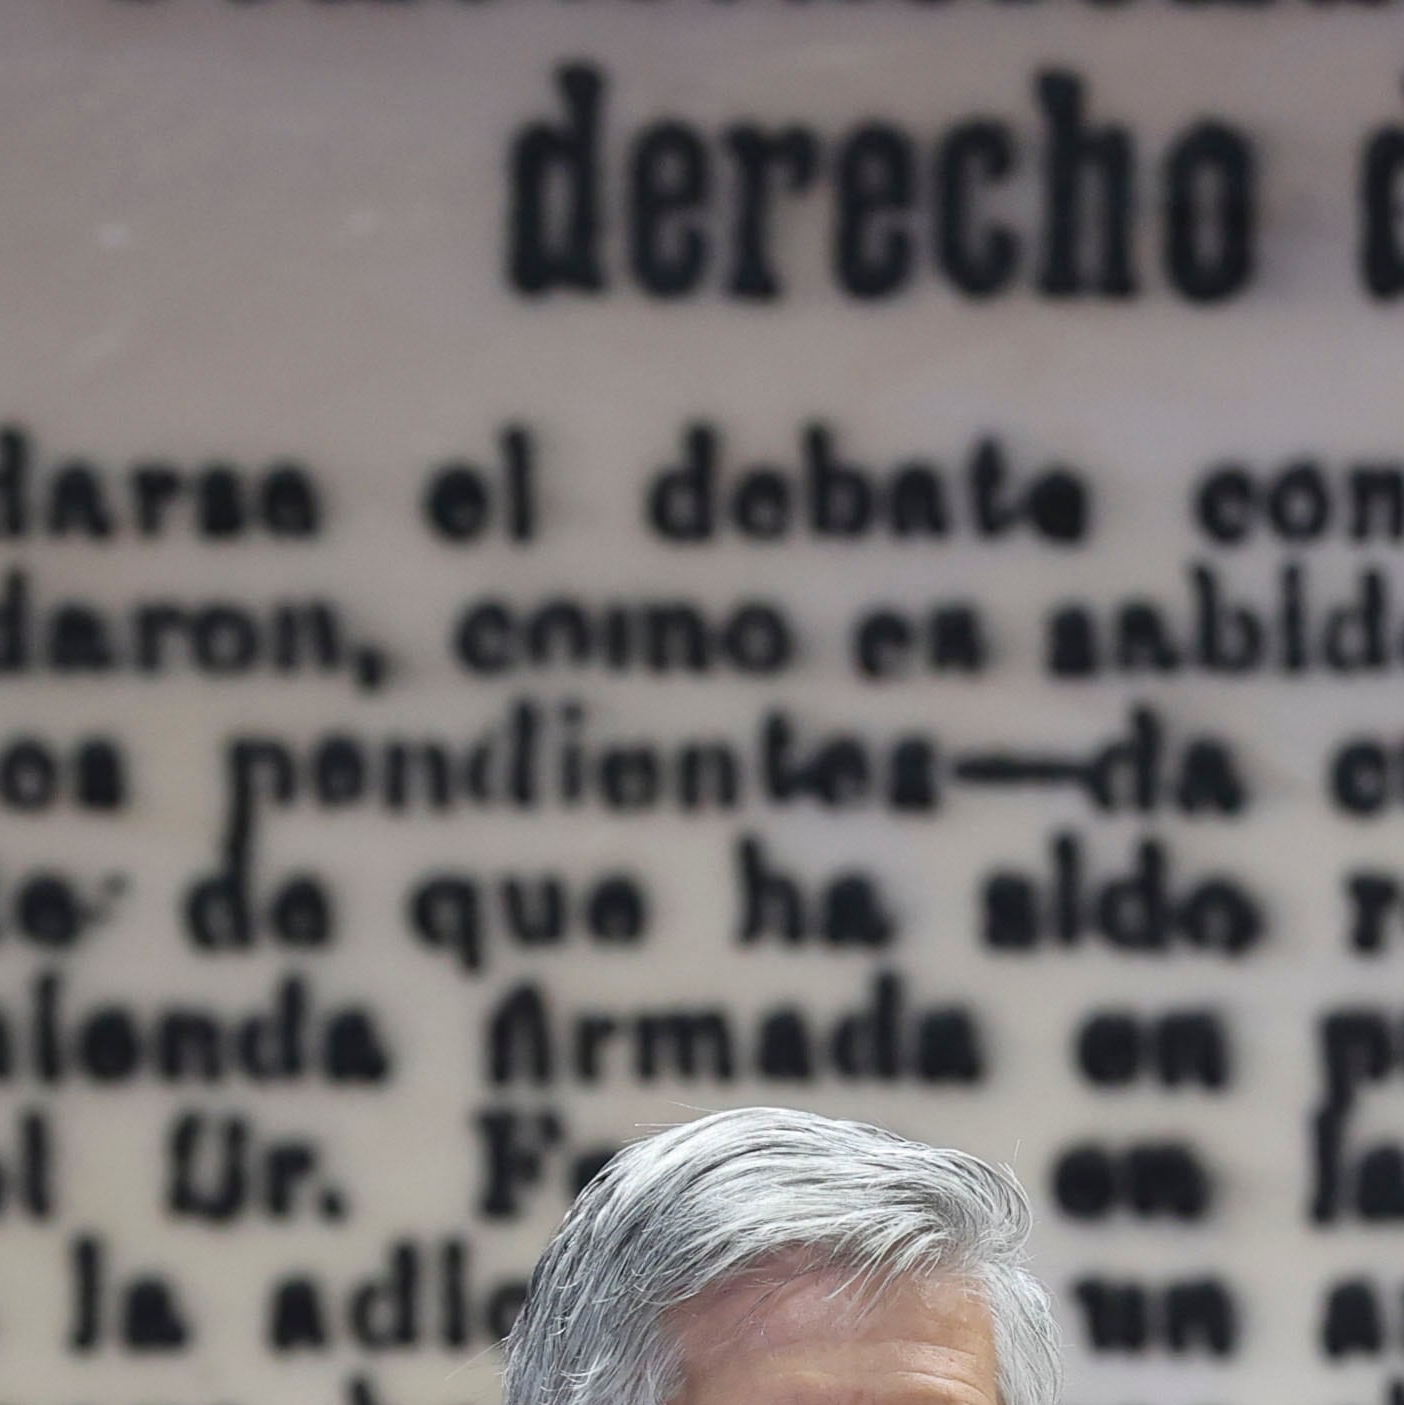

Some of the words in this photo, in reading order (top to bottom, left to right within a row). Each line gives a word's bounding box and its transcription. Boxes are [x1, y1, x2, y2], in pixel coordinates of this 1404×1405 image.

[506, 61, 1263, 307] derecho
[421, 425, 539, 545] el
[645, 423, 1092, 547] debate
[453, 599, 798, 676] como
[406, 874, 650, 975] que
[736, 835, 899, 954] ha
[1076, 1011, 1230, 1091] en
[1052, 1144, 1213, 1223] en
[70, 1235, 191, 1355] la
[1073, 1278, 1238, 1358] un
